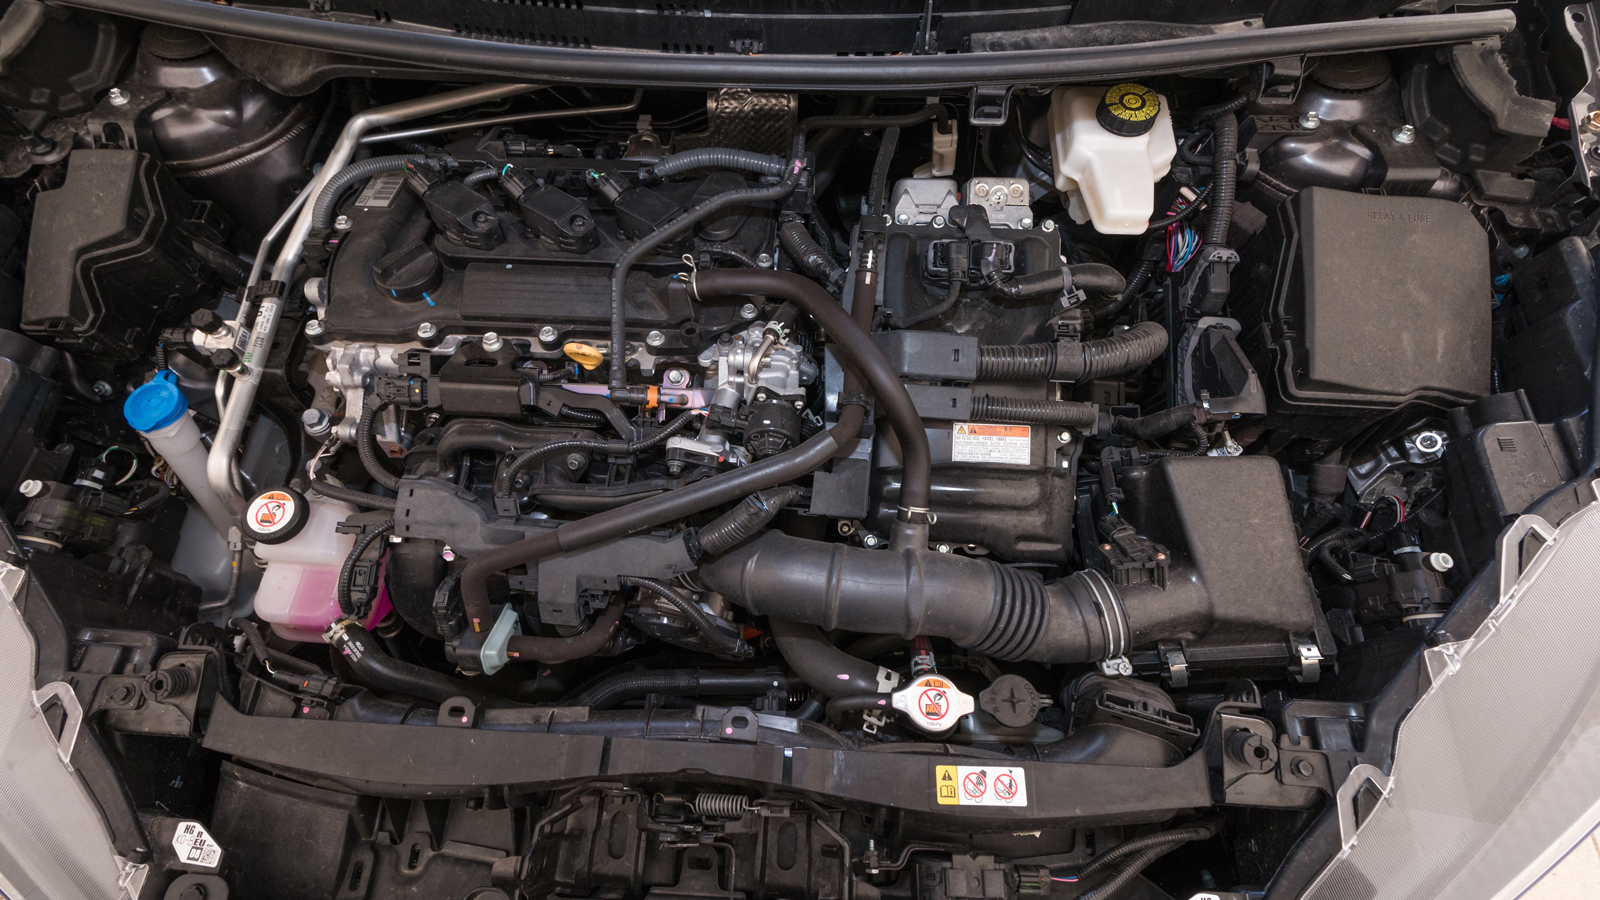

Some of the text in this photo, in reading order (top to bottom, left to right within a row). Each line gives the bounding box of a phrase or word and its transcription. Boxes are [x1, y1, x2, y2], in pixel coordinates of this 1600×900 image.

[1367, 210, 1432, 223] RELAY & FUSE
[1024, 683, 1038, 719] COOLANT
[183, 824, 196, 834] HG
[193, 838, 206, 847] EU
